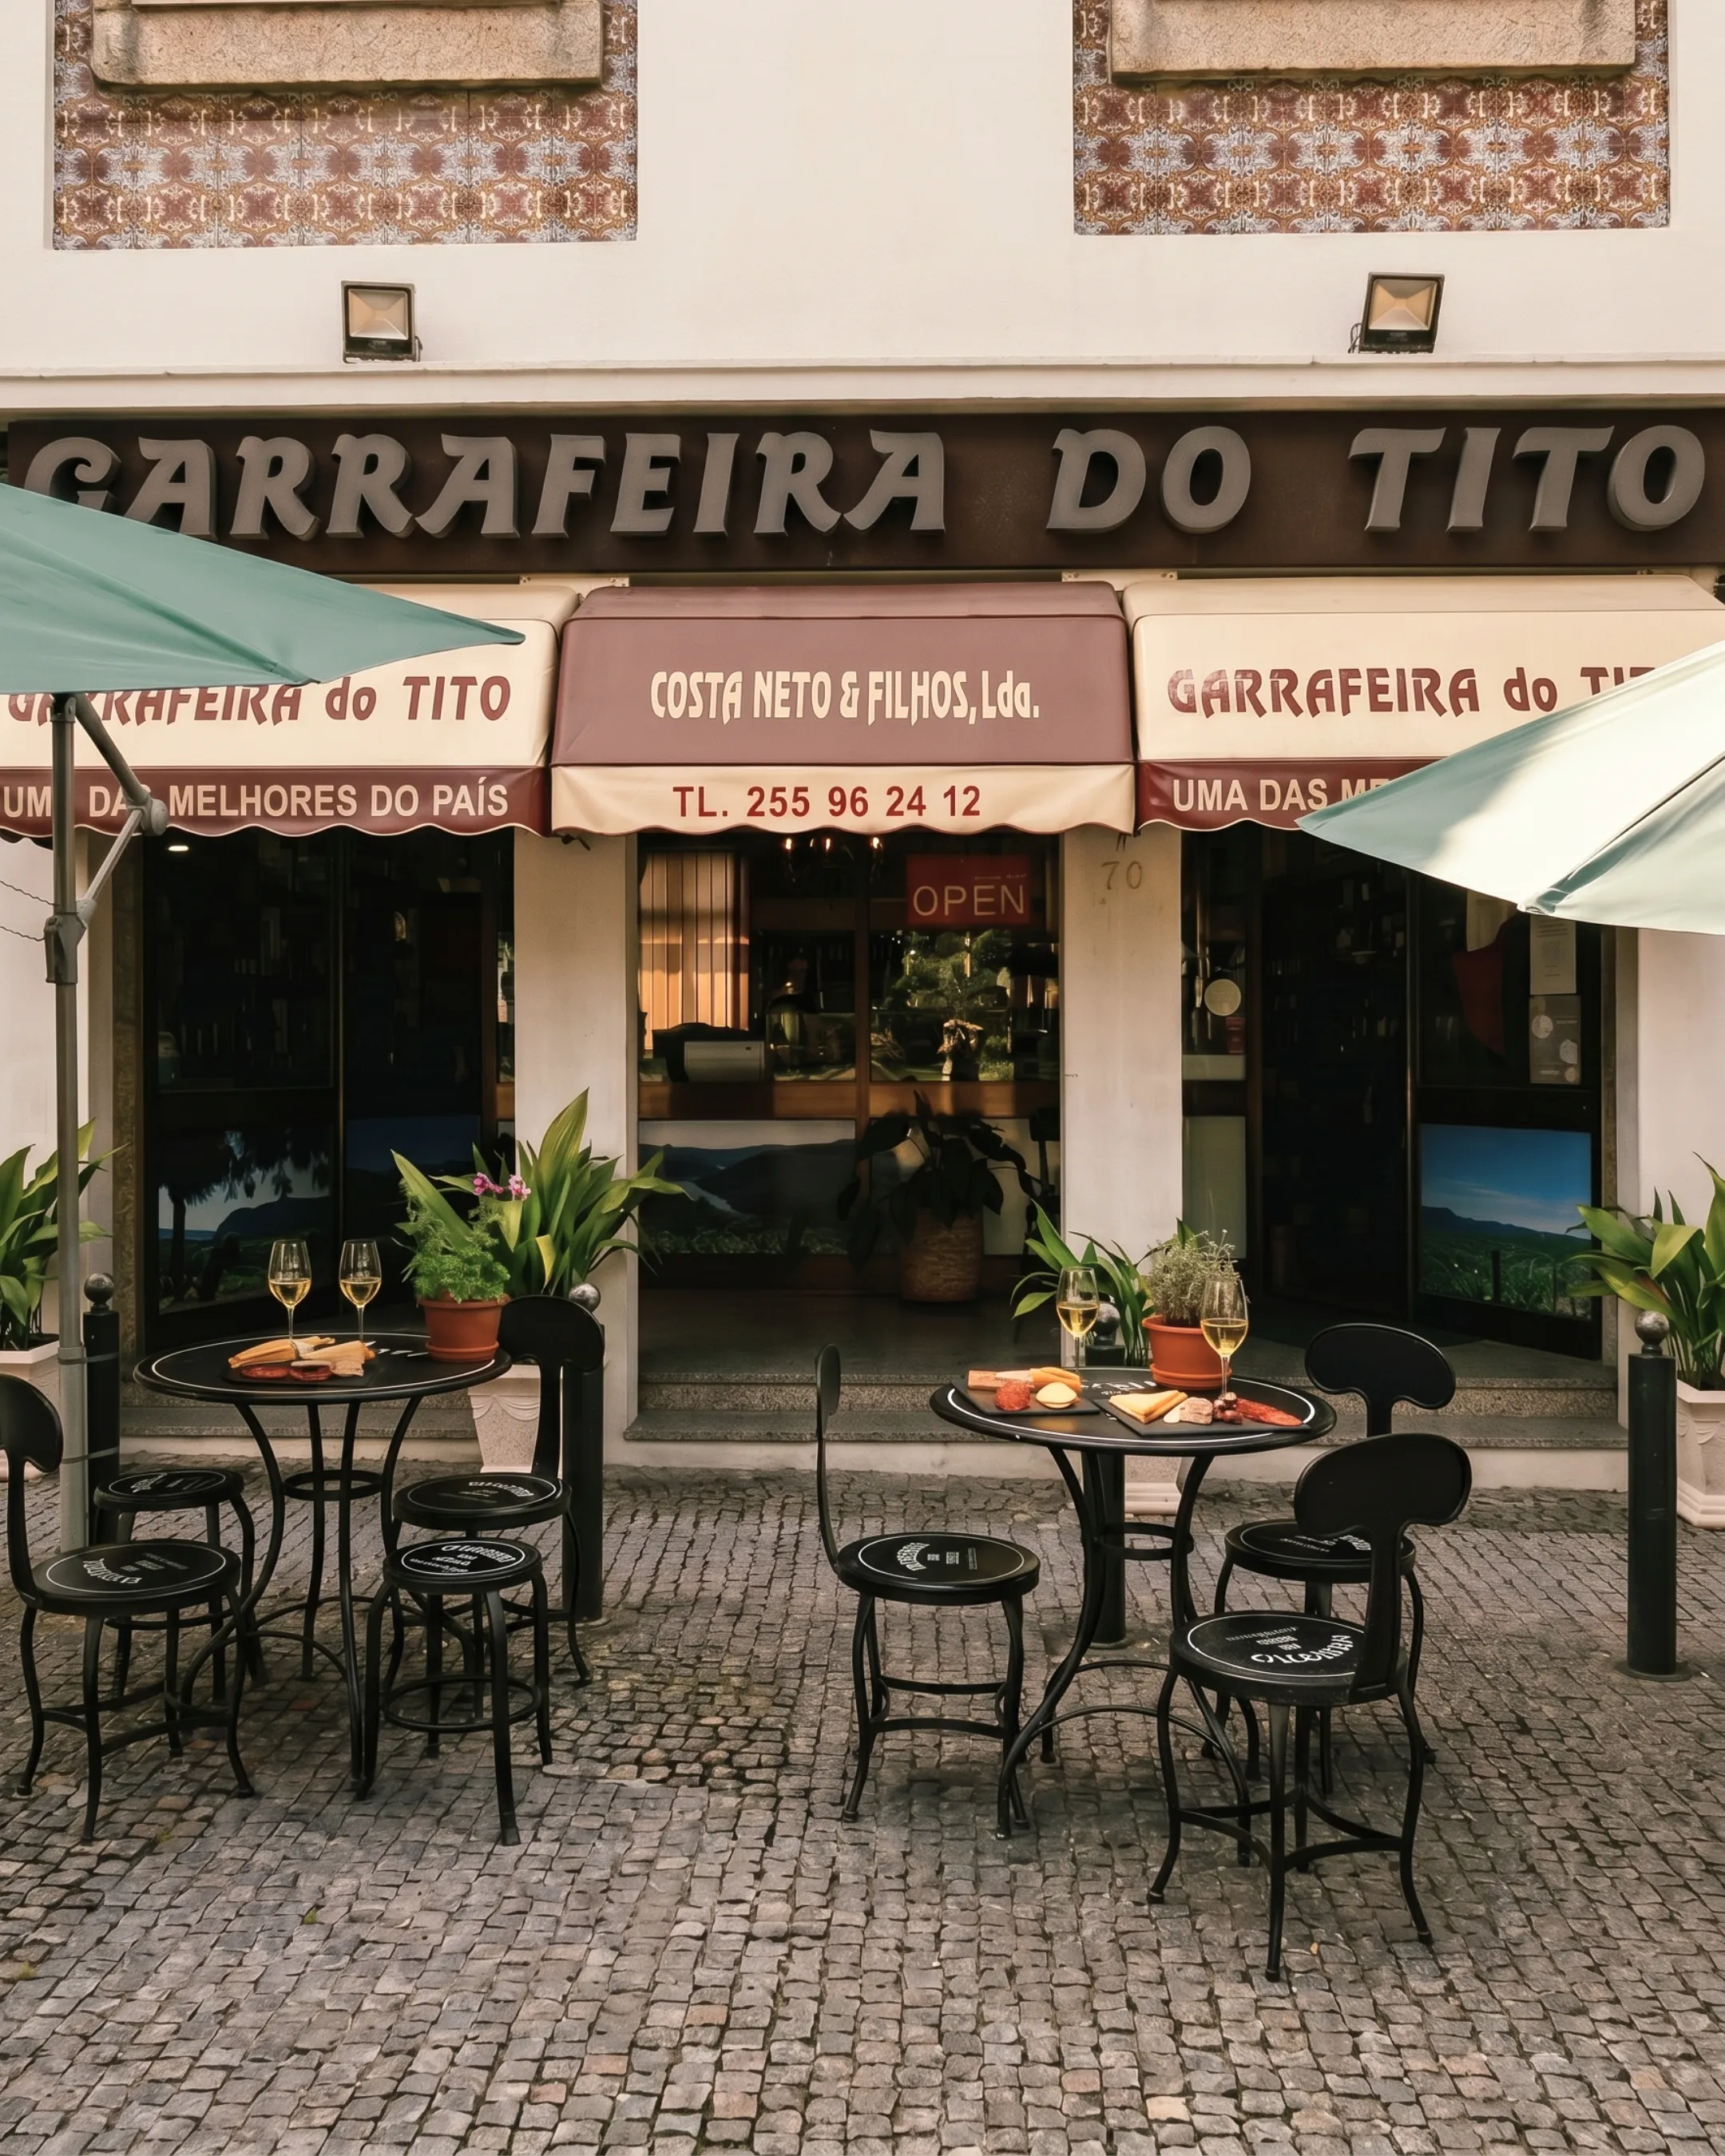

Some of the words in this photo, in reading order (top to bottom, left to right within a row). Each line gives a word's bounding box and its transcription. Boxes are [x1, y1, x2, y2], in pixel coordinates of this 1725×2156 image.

[22, 428, 946, 538] GARRAFEIRA
[1045, 426, 1251, 533] DO
[1347, 425, 1707, 532] TITO
[324, 677, 377, 719] do
[402, 676, 511, 720] TITO
[650, 671, 744, 725] COSTA
[753, 671, 832, 719] NETO
[839, 671, 860, 718] &
[867, 671, 977, 726] FILHOS,
[1167, 668, 1481, 719] GARRAFEIRA
[1503, 667, 1557, 712] do
[169, 785, 357, 817] MELHORES
[371, 785, 419, 817] DO
[431, 777, 509, 817] PAÍS
[672, 787, 728, 817] TL.
[747, 786, 810, 817] 255
[828, 786, 869, 817] 96
[886, 786, 926, 816] 24
[943, 786, 981, 816] 12
[1173, 779, 1248, 812] UMA
[1259, 779, 1329, 811] DAS
[1101, 861, 1143, 890] 70
[913, 885, 1025, 917] OPEN
